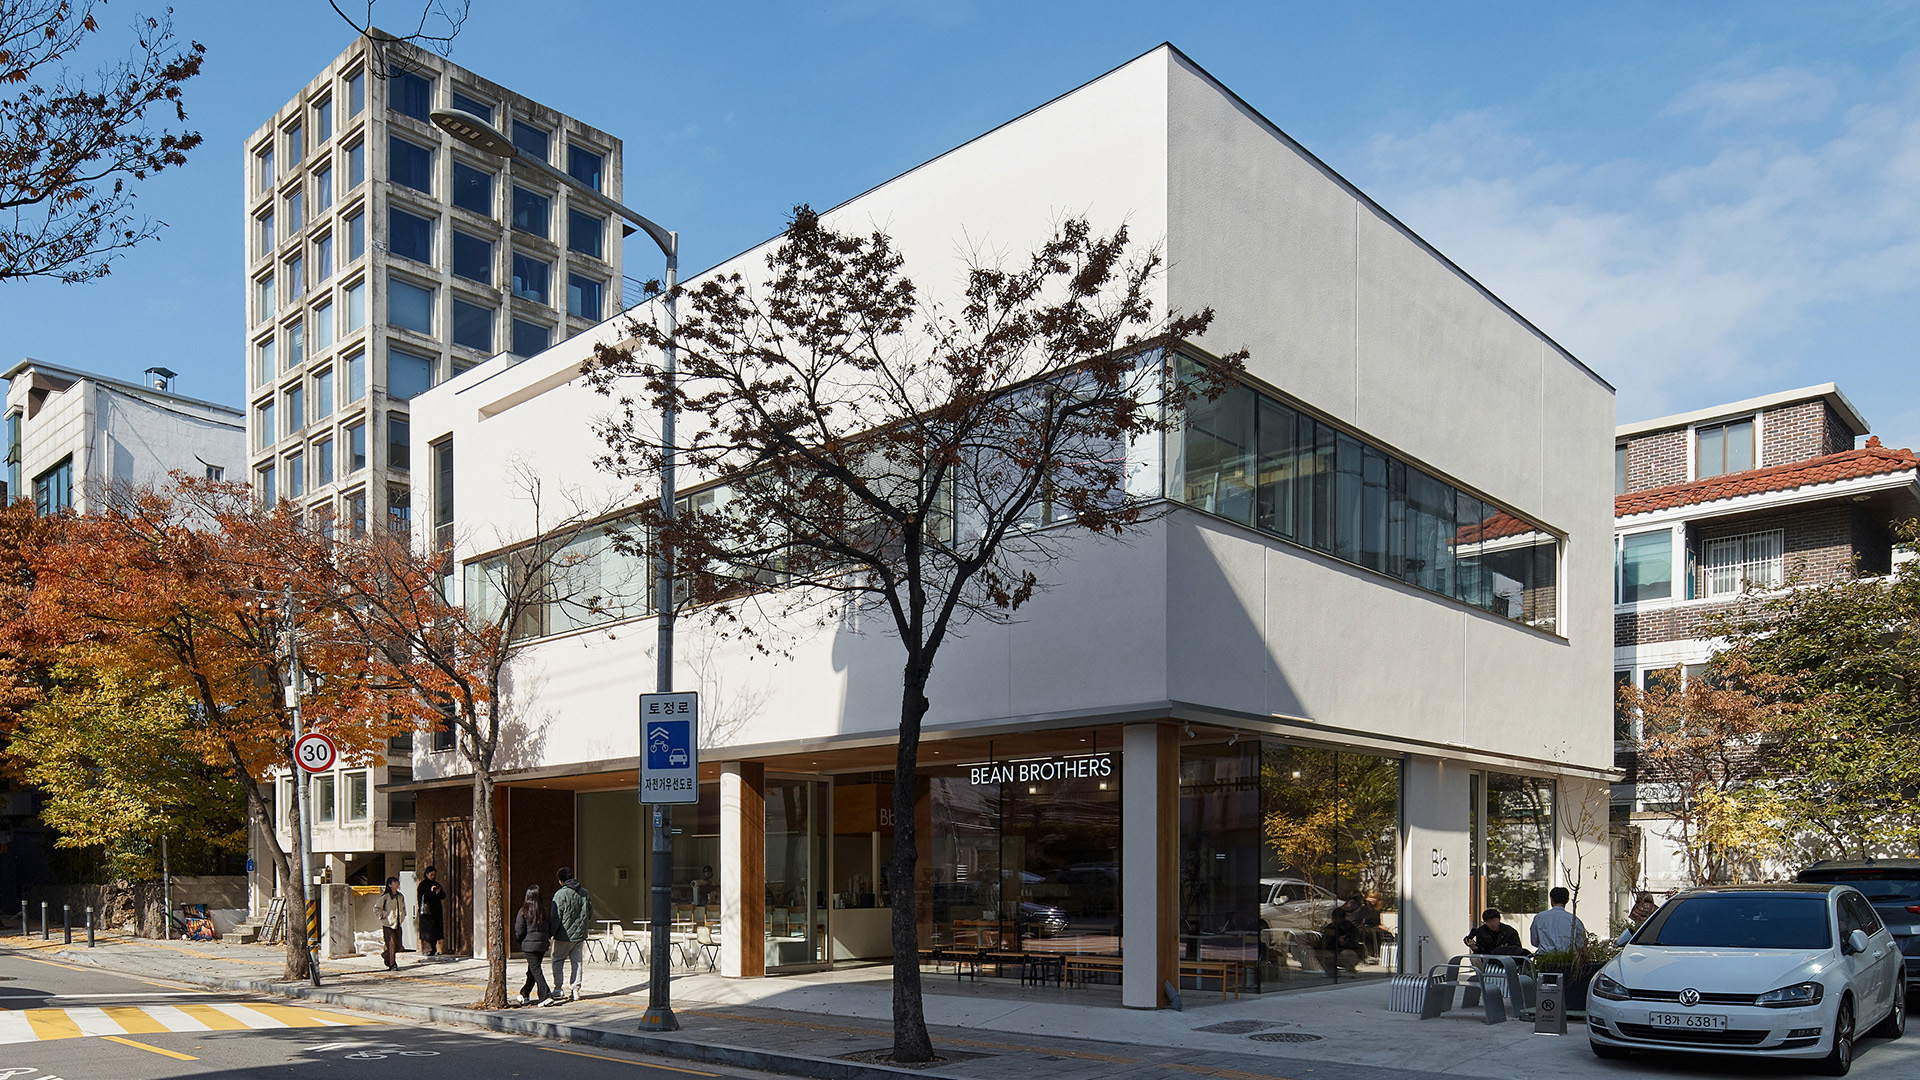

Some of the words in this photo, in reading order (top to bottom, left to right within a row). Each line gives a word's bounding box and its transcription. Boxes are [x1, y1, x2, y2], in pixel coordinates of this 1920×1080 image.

[648, 701, 690, 715] 토정로
[303, 743, 328, 762] 30
[970, 765, 1014, 785] BEAN
[1019, 757, 1112, 782] BROTHERS
[645, 777, 693, 791] 자전거우선도로
[1656, 1014, 1681, 1026] 18가
[1686, 1015, 1719, 1028] 6381
